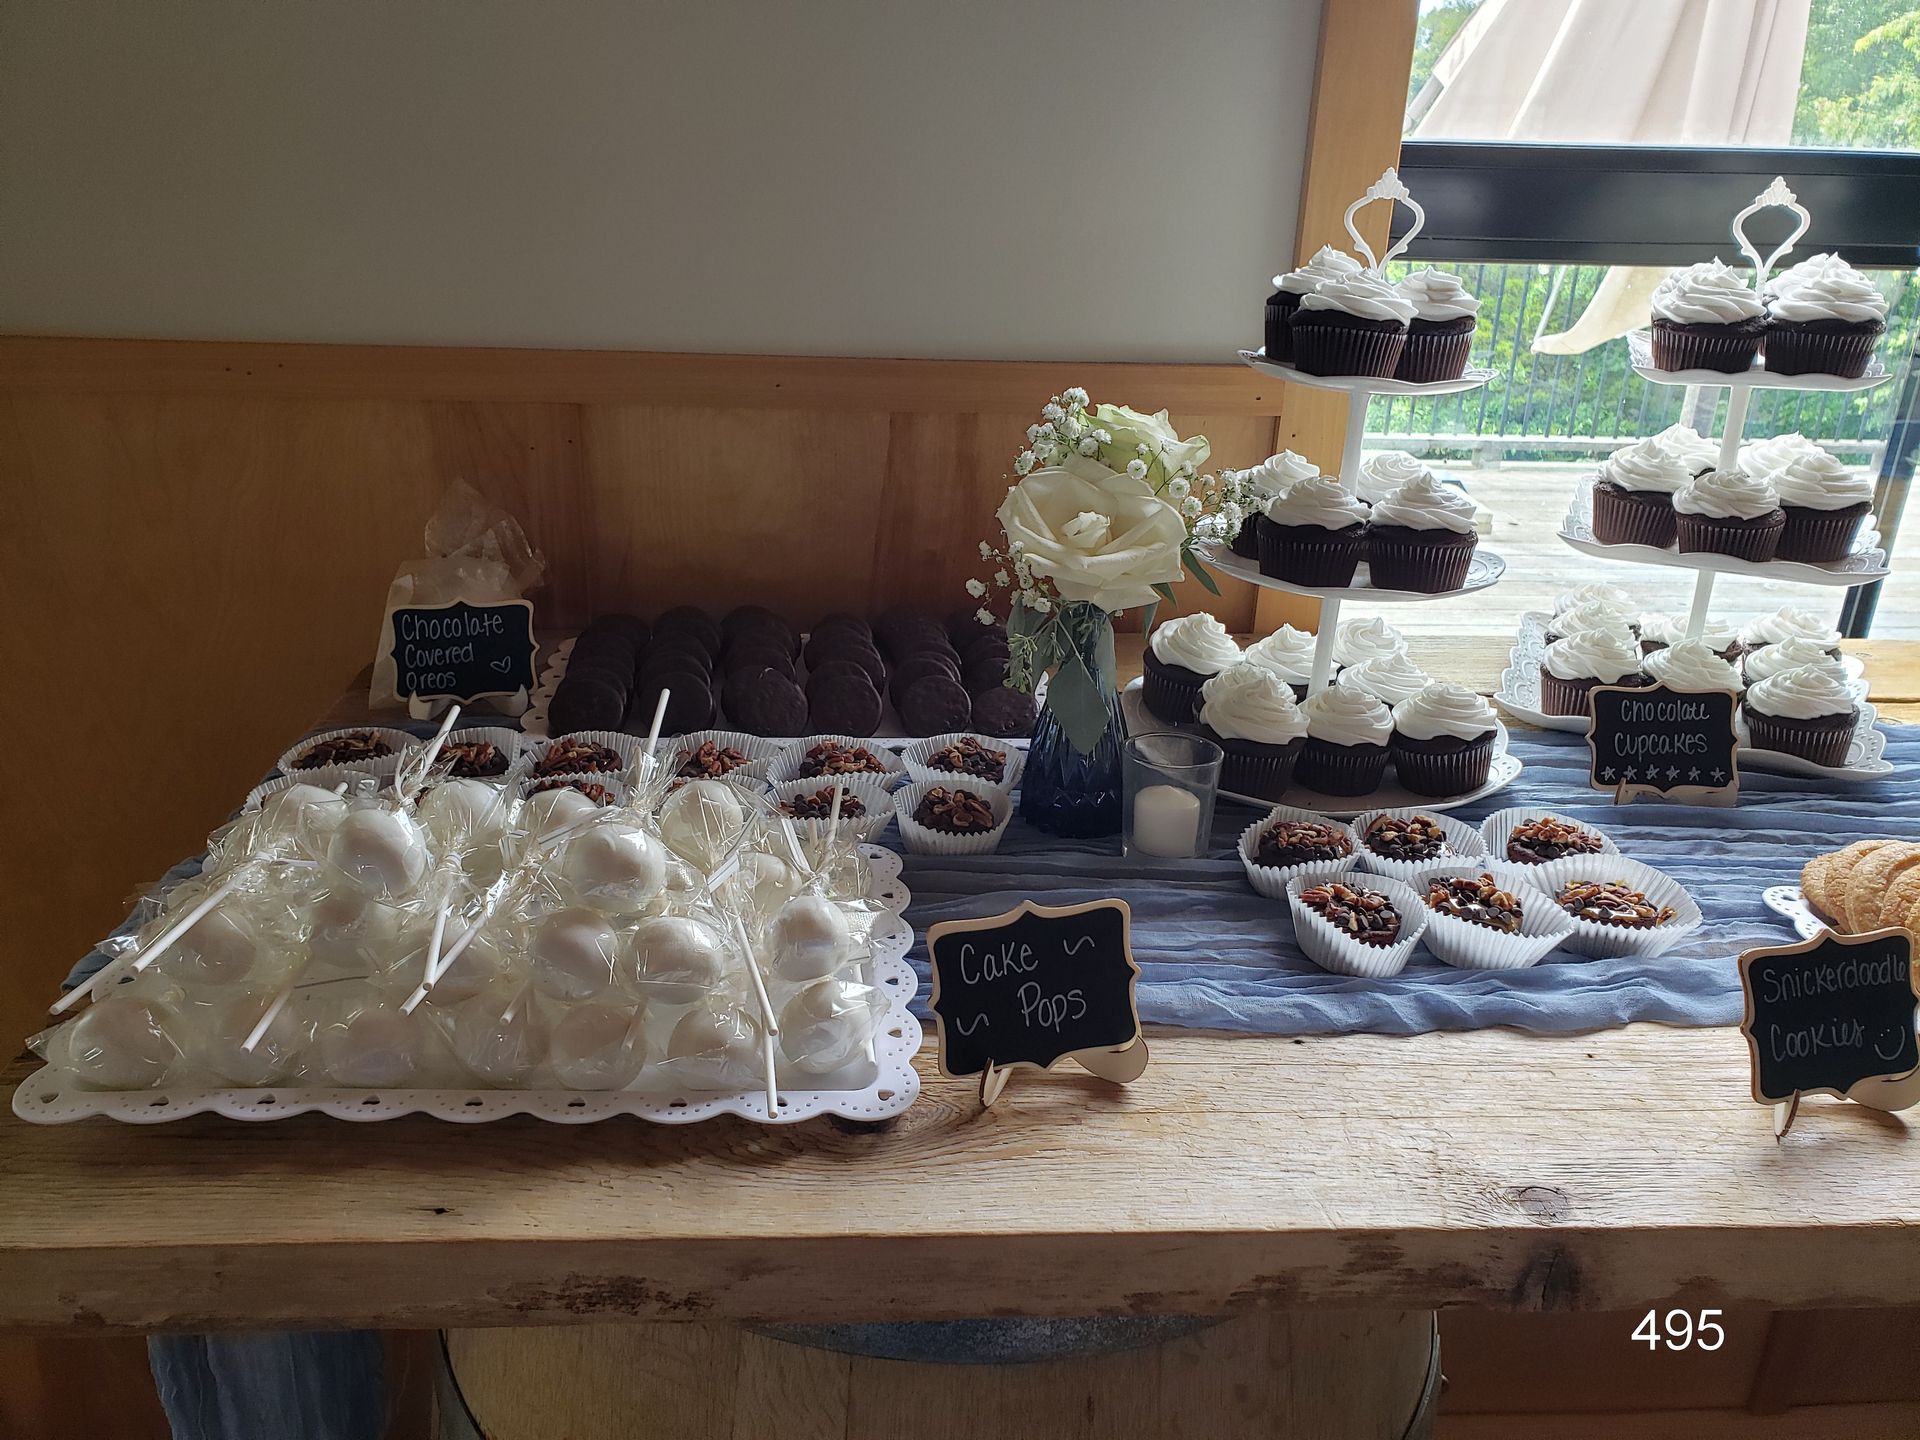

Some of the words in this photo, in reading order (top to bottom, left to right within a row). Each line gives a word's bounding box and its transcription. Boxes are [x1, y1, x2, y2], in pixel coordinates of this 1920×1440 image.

[402, 611, 504, 641] Chocolate
[405, 642, 474, 669] Covered
[1614, 731, 1708, 763] Cupcakes
[960, 941, 1039, 985] Cake
[1763, 953, 1907, 1003] Snickerdoodle
[1017, 981, 1087, 1033] Pops
[1770, 1017, 1865, 1062] Cookies
